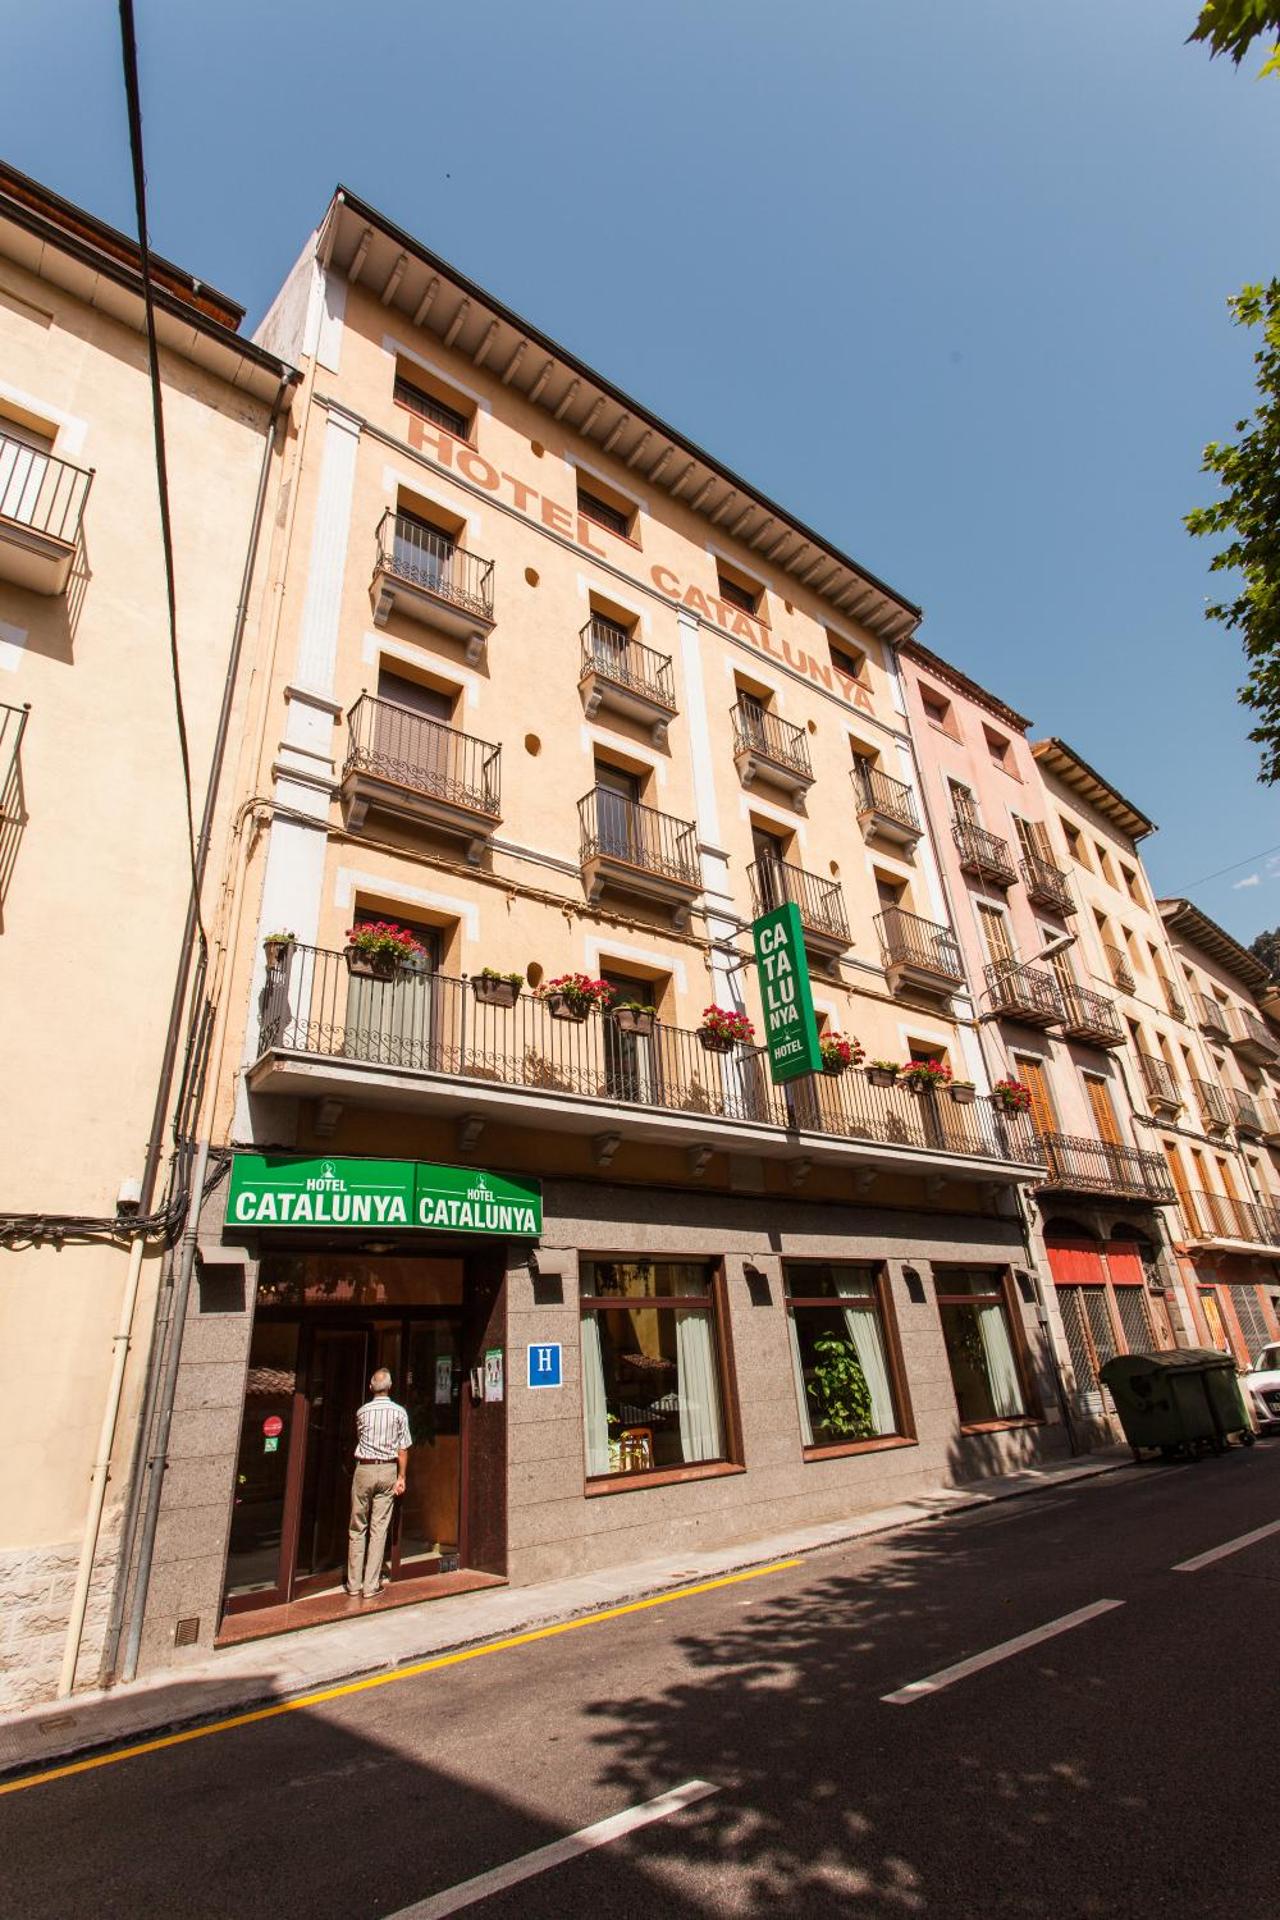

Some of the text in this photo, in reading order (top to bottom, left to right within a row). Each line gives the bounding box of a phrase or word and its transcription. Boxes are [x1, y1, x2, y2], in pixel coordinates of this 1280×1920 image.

[407, 416, 876, 715] HOTEL CATALUNYA
[759, 922, 788, 954] CA
[763, 951, 792, 981] TA
[768, 976, 795, 1010] LU
[769, 1005, 799, 1031] NYA
[774, 1039, 803, 1060] HOTEL
[306, 1178, 348, 1192] HOTEL
[467, 1188, 496, 1203] HOTEL
[235, 1192, 408, 1222] CATALUNYA
[419, 1198, 537, 1232] CATALUNYA
[537, 1348, 553, 1371] H
